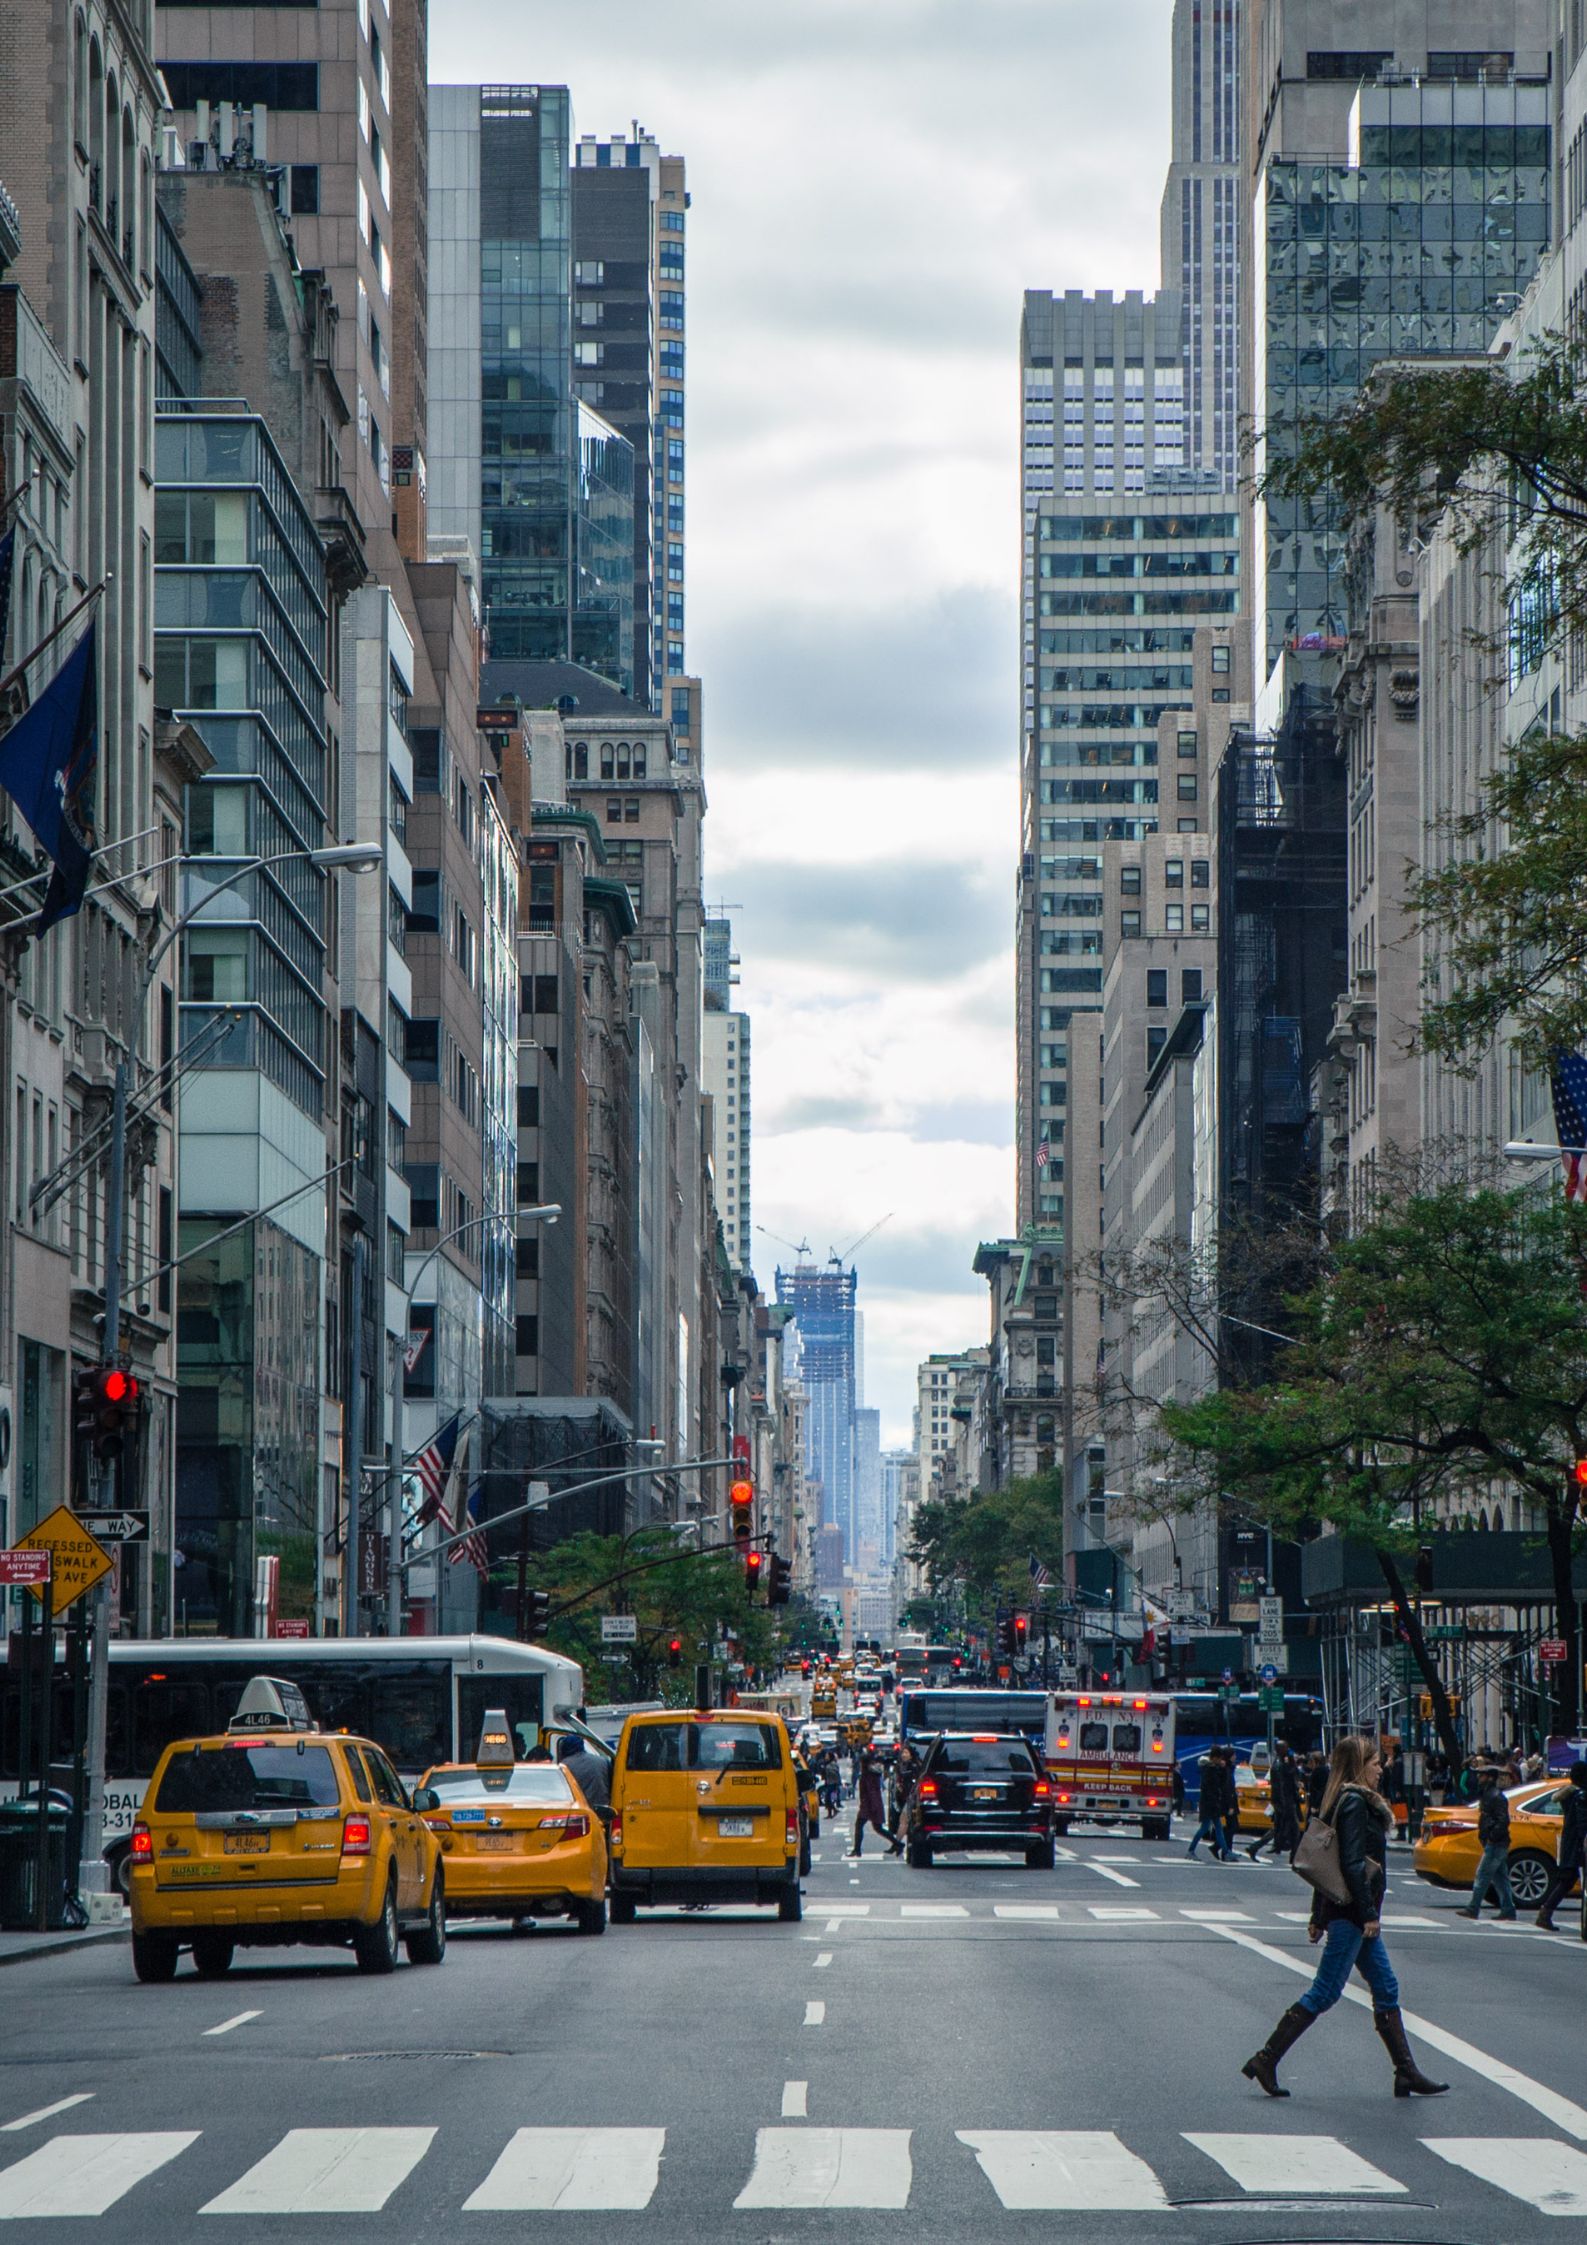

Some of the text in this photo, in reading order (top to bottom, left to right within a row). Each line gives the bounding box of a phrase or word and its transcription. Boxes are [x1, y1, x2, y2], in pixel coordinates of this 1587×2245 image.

[107, 1521, 135, 1533] WAY
[27, 1539, 93, 1553] RECESSED
[13, 1553, 47, 1561] STANDING
[55, 1555, 98, 1569] SWALK
[6, 1562, 41, 1571] ANYTIME
[64, 1572, 88, 1584] AVE
[476, 1659, 484, 1670] 8
[244, 1714, 271, 1726] 4L46
[1080, 1750, 1140, 1762] AMBULANCE
[1083, 1783, 1133, 1792] KEEP BACK
